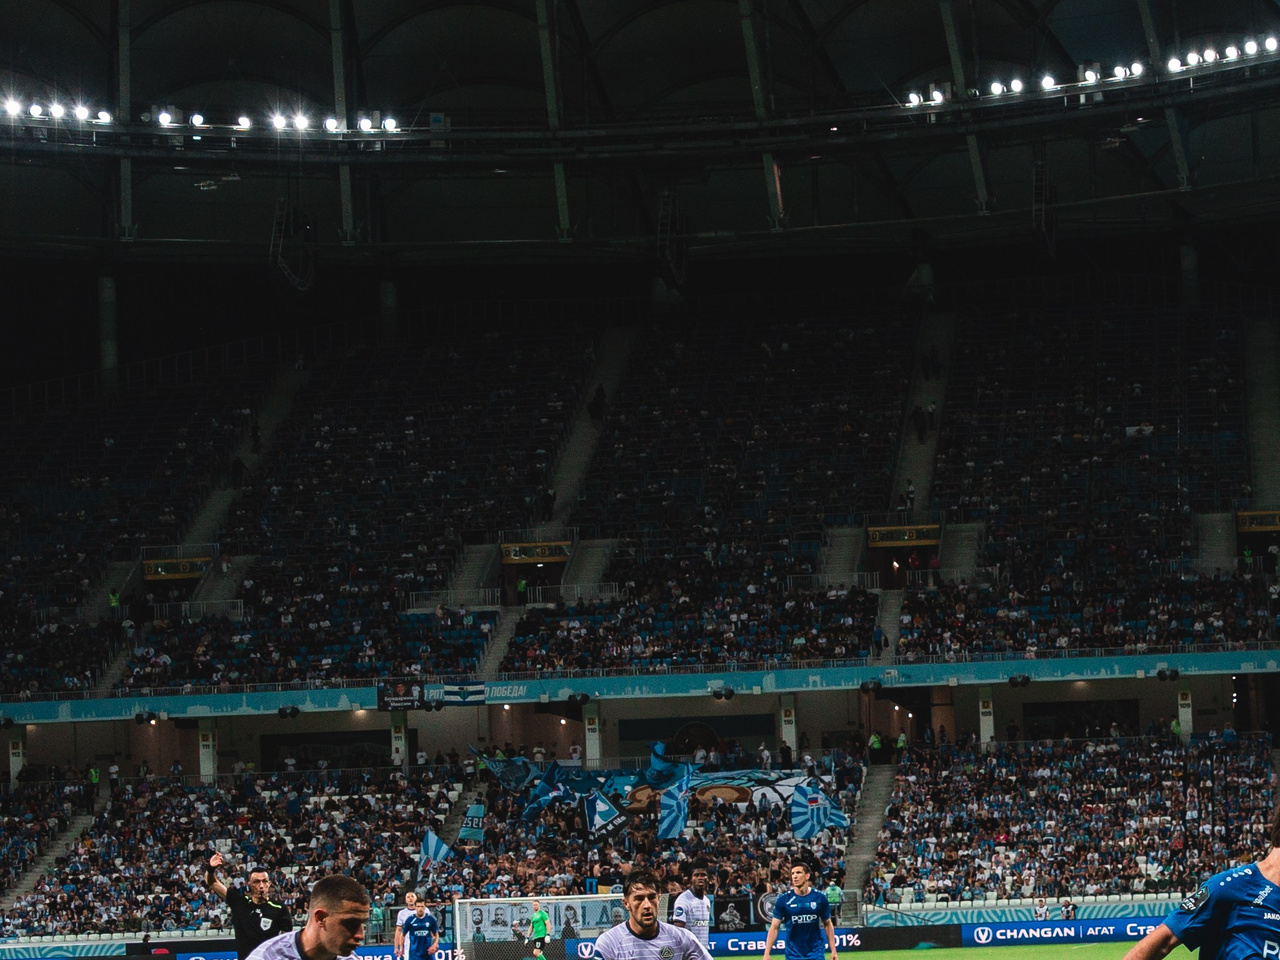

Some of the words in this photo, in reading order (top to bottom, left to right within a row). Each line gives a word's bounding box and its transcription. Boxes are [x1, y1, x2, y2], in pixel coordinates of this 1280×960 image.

[490, 685, 527, 698] ПОБЕДА!
[791, 914, 818, 924] РОТОР
[1263, 912, 1280, 921] JAKO
[996, 926, 1075, 940] CHANGAN
[1086, 926, 1116, 936] АГАТ
[1126, 923, 1159, 936] Ста
